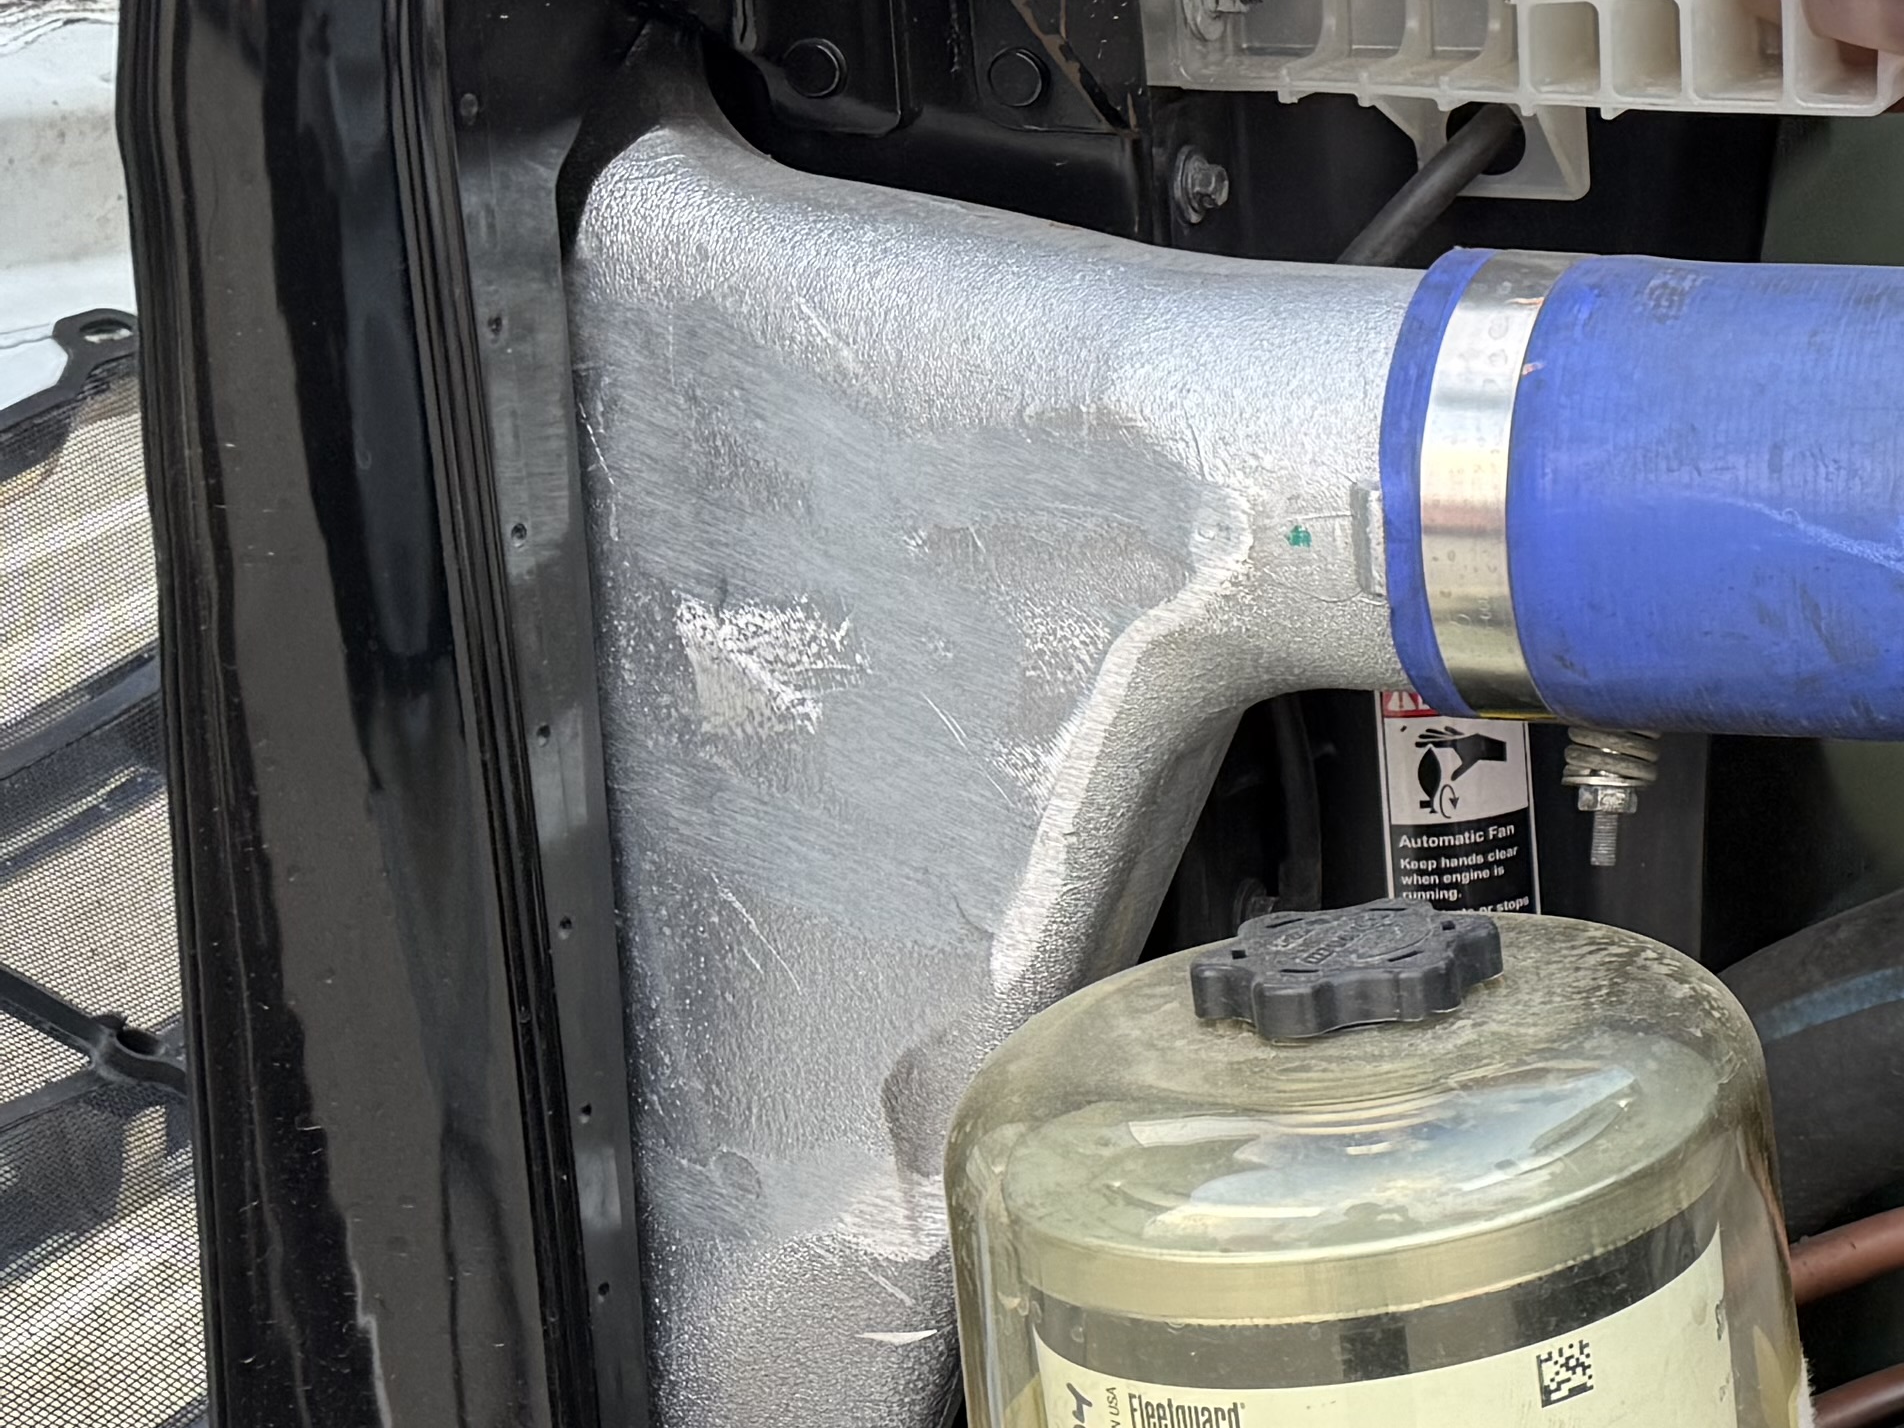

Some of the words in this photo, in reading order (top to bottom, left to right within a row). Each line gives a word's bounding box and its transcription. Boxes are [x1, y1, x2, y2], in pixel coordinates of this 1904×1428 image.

[1399, 830, 1484, 848] Automatic
[1488, 824, 1515, 839] Fan
[1400, 858, 1437, 871] Keep
[1441, 852, 1484, 867] hands
[1487, 846, 1518, 862] clear
[1401, 873, 1439, 885] when
[1443, 868, 1490, 885] engine
[1494, 865, 1505, 877] is
[1402, 888, 1462, 902] running.
[1496, 895, 1530, 912] stops
[1105, 1386, 1119, 1416] USA
